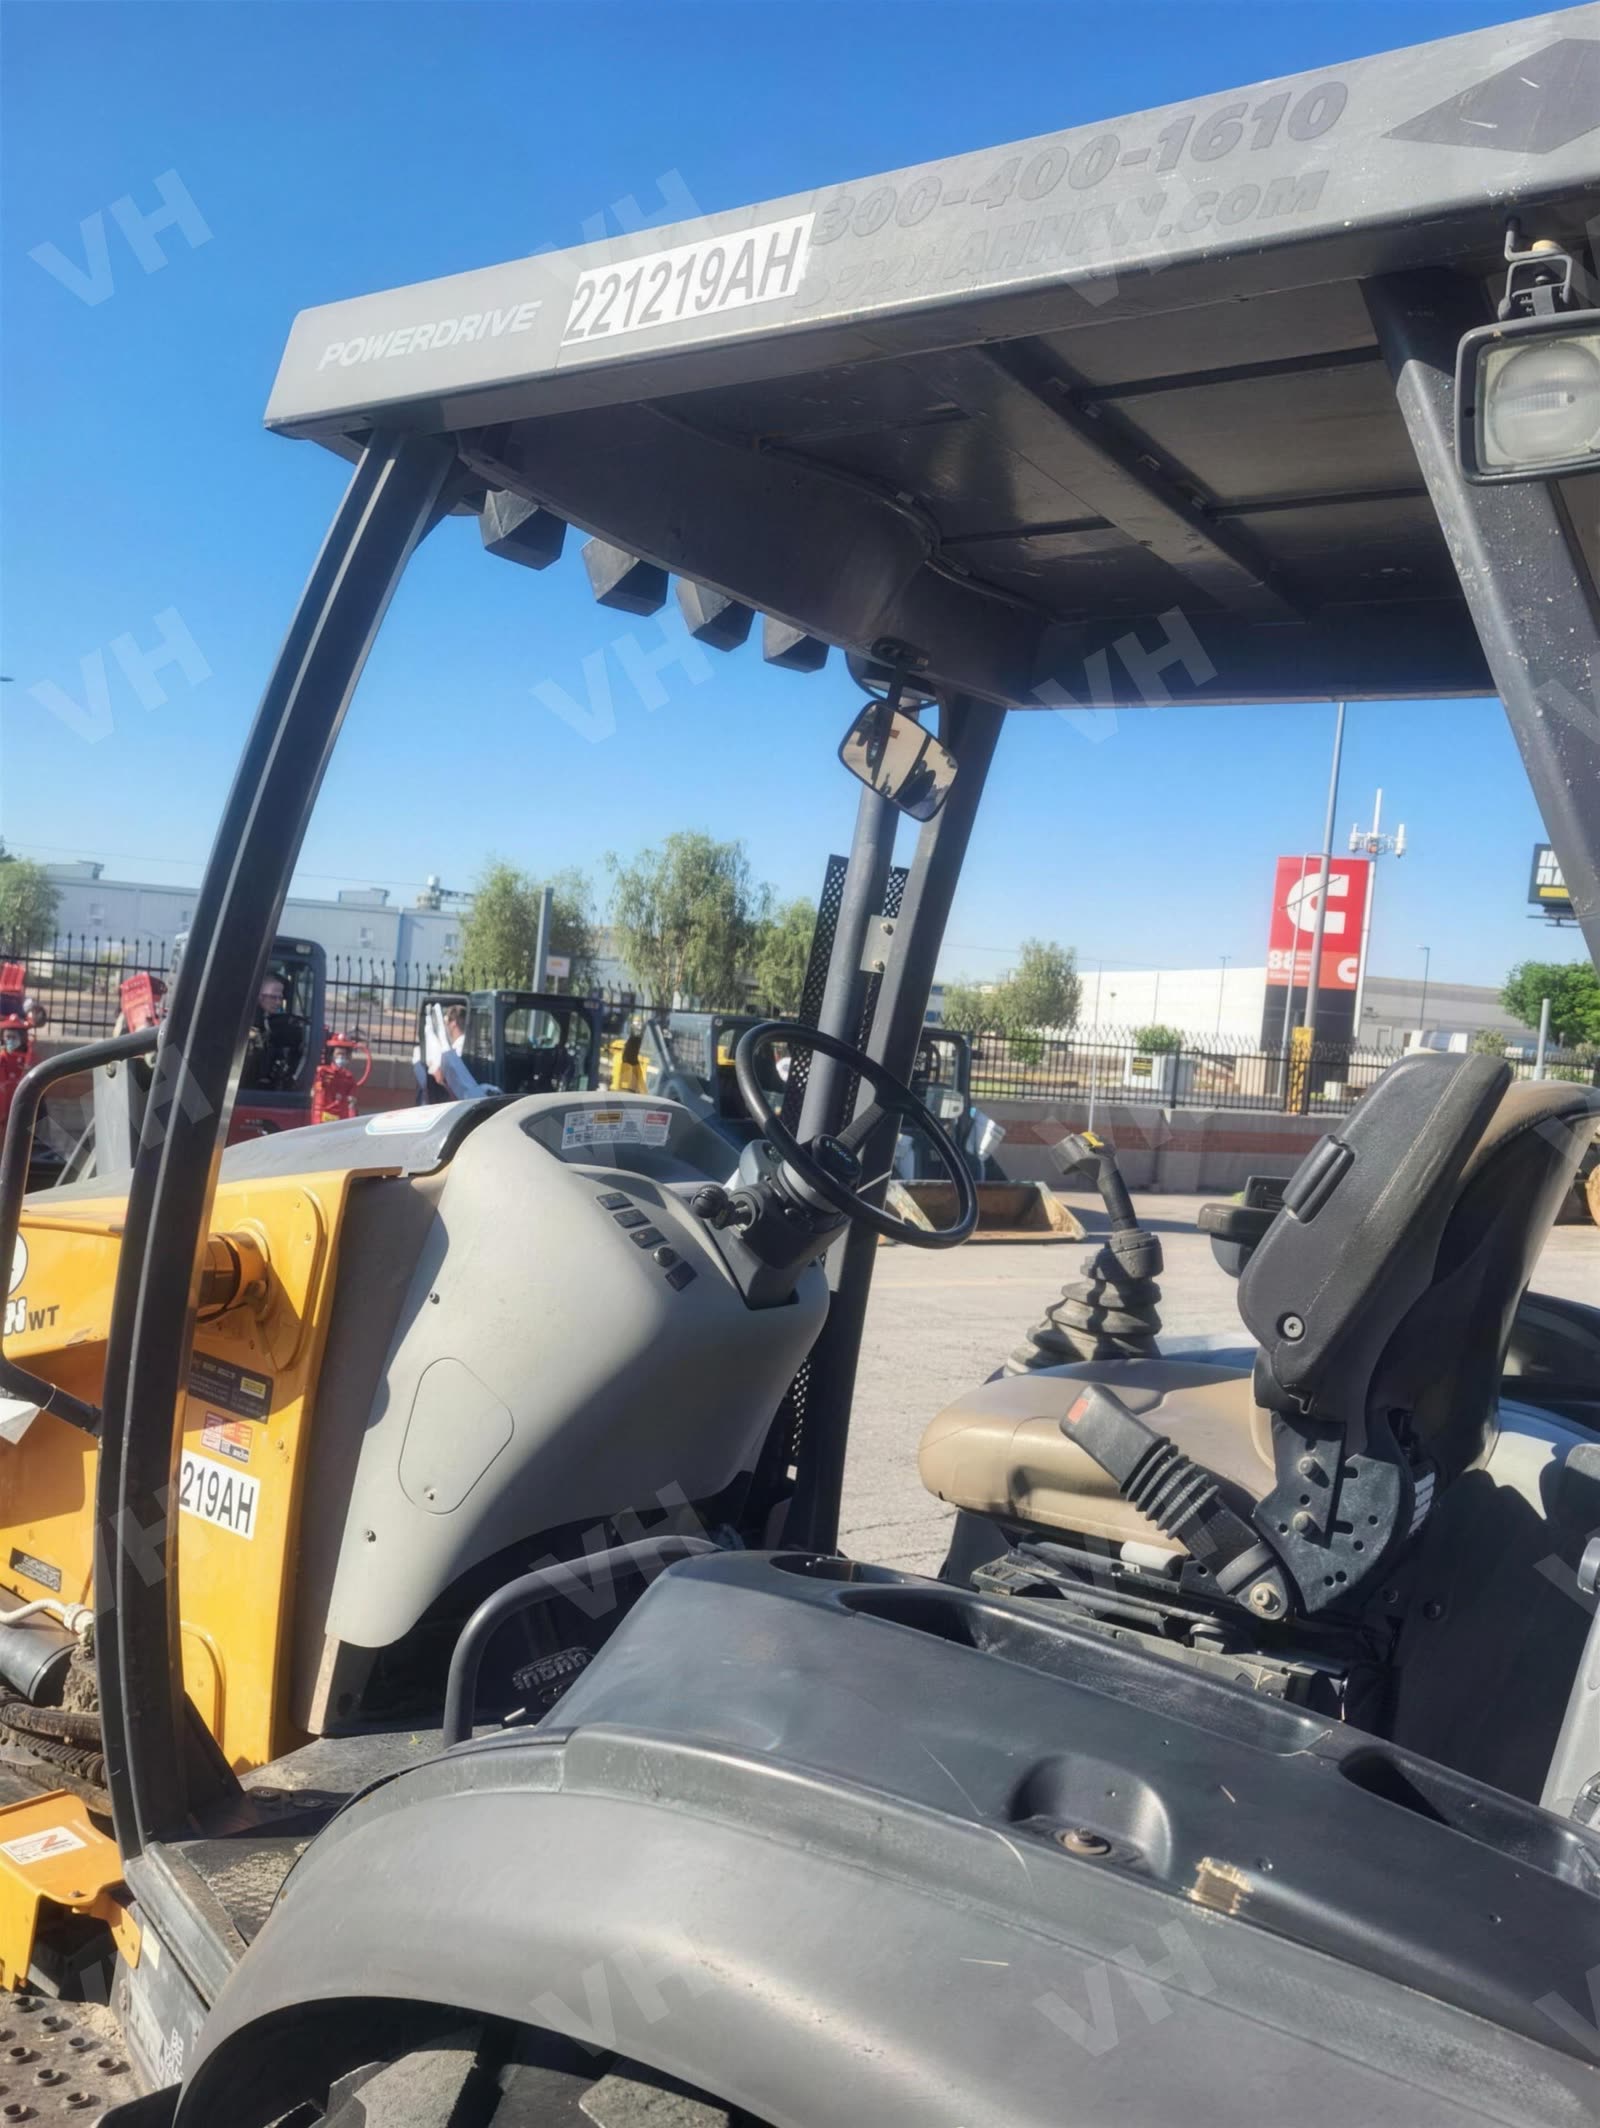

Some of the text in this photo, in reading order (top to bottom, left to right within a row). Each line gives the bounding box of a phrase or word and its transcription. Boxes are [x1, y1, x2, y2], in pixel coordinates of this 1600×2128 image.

[562, 226, 803, 341] 221219AH
[316, 301, 542, 371] POWERDRIVE
[28, 1304, 60, 1332] WT
[179, 1460, 255, 1534] 219AH
